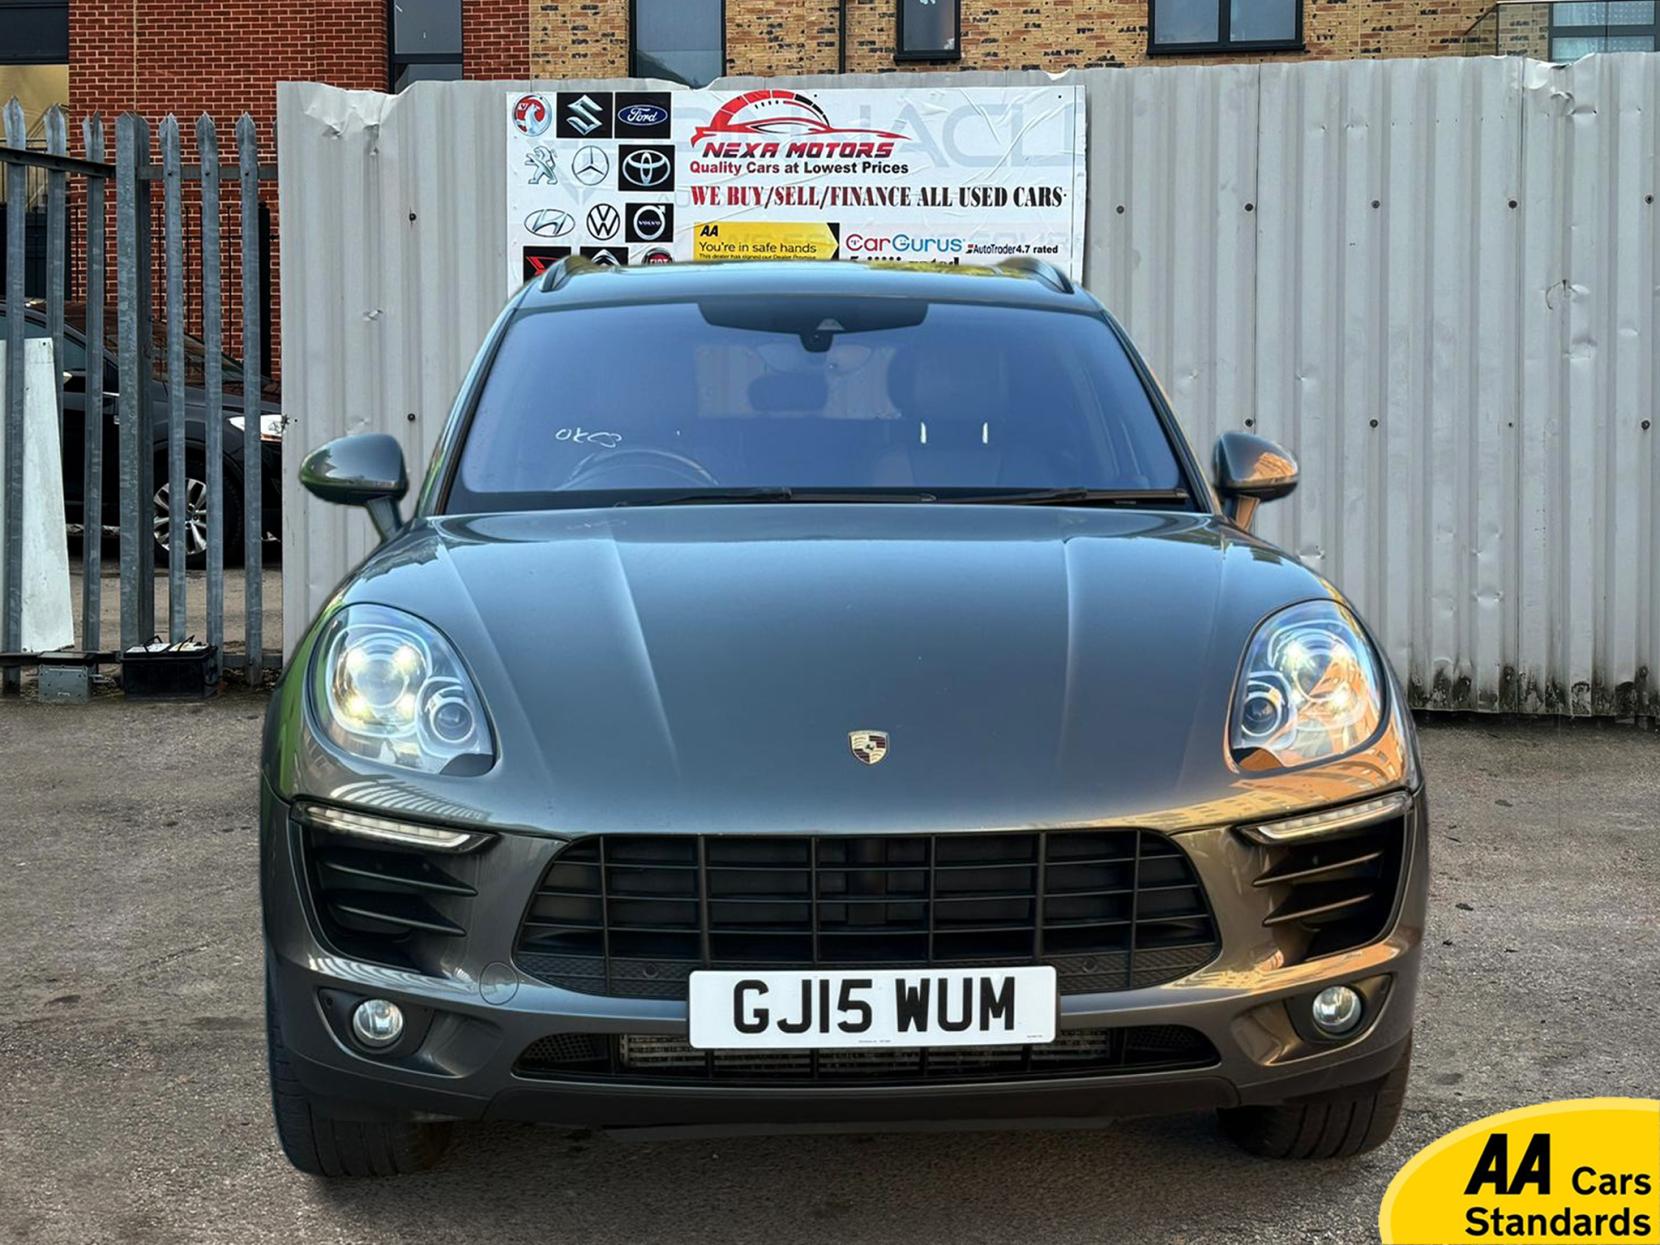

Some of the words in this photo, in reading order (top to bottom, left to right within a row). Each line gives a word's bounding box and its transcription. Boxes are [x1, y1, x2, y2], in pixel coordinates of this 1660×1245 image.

[627, 107, 657, 122] Ford
[702, 142, 780, 159] NEXA
[785, 142, 895, 159] MOTORS
[689, 161, 742, 176] Quality
[746, 161, 780, 174] Cars
[784, 162, 799, 174] at
[803, 161, 857, 174] Lowest
[862, 161, 909, 174] Prices
[690, 185, 721, 207] WE
[917, 186, 953, 208] ALL
[958, 186, 1008, 208] USED
[700, 225, 719, 237] AA
[699, 241, 736, 253] You're
[738, 242, 749, 252] in
[752, 242, 777, 253] safe
[780, 243, 817, 254] hands
[846, 233, 963, 252] CarGurus
[1033, 244, 1059, 254] rated
[733, 978, 873, 1034] GJ15
[895, 976, 1016, 1032] WUM
